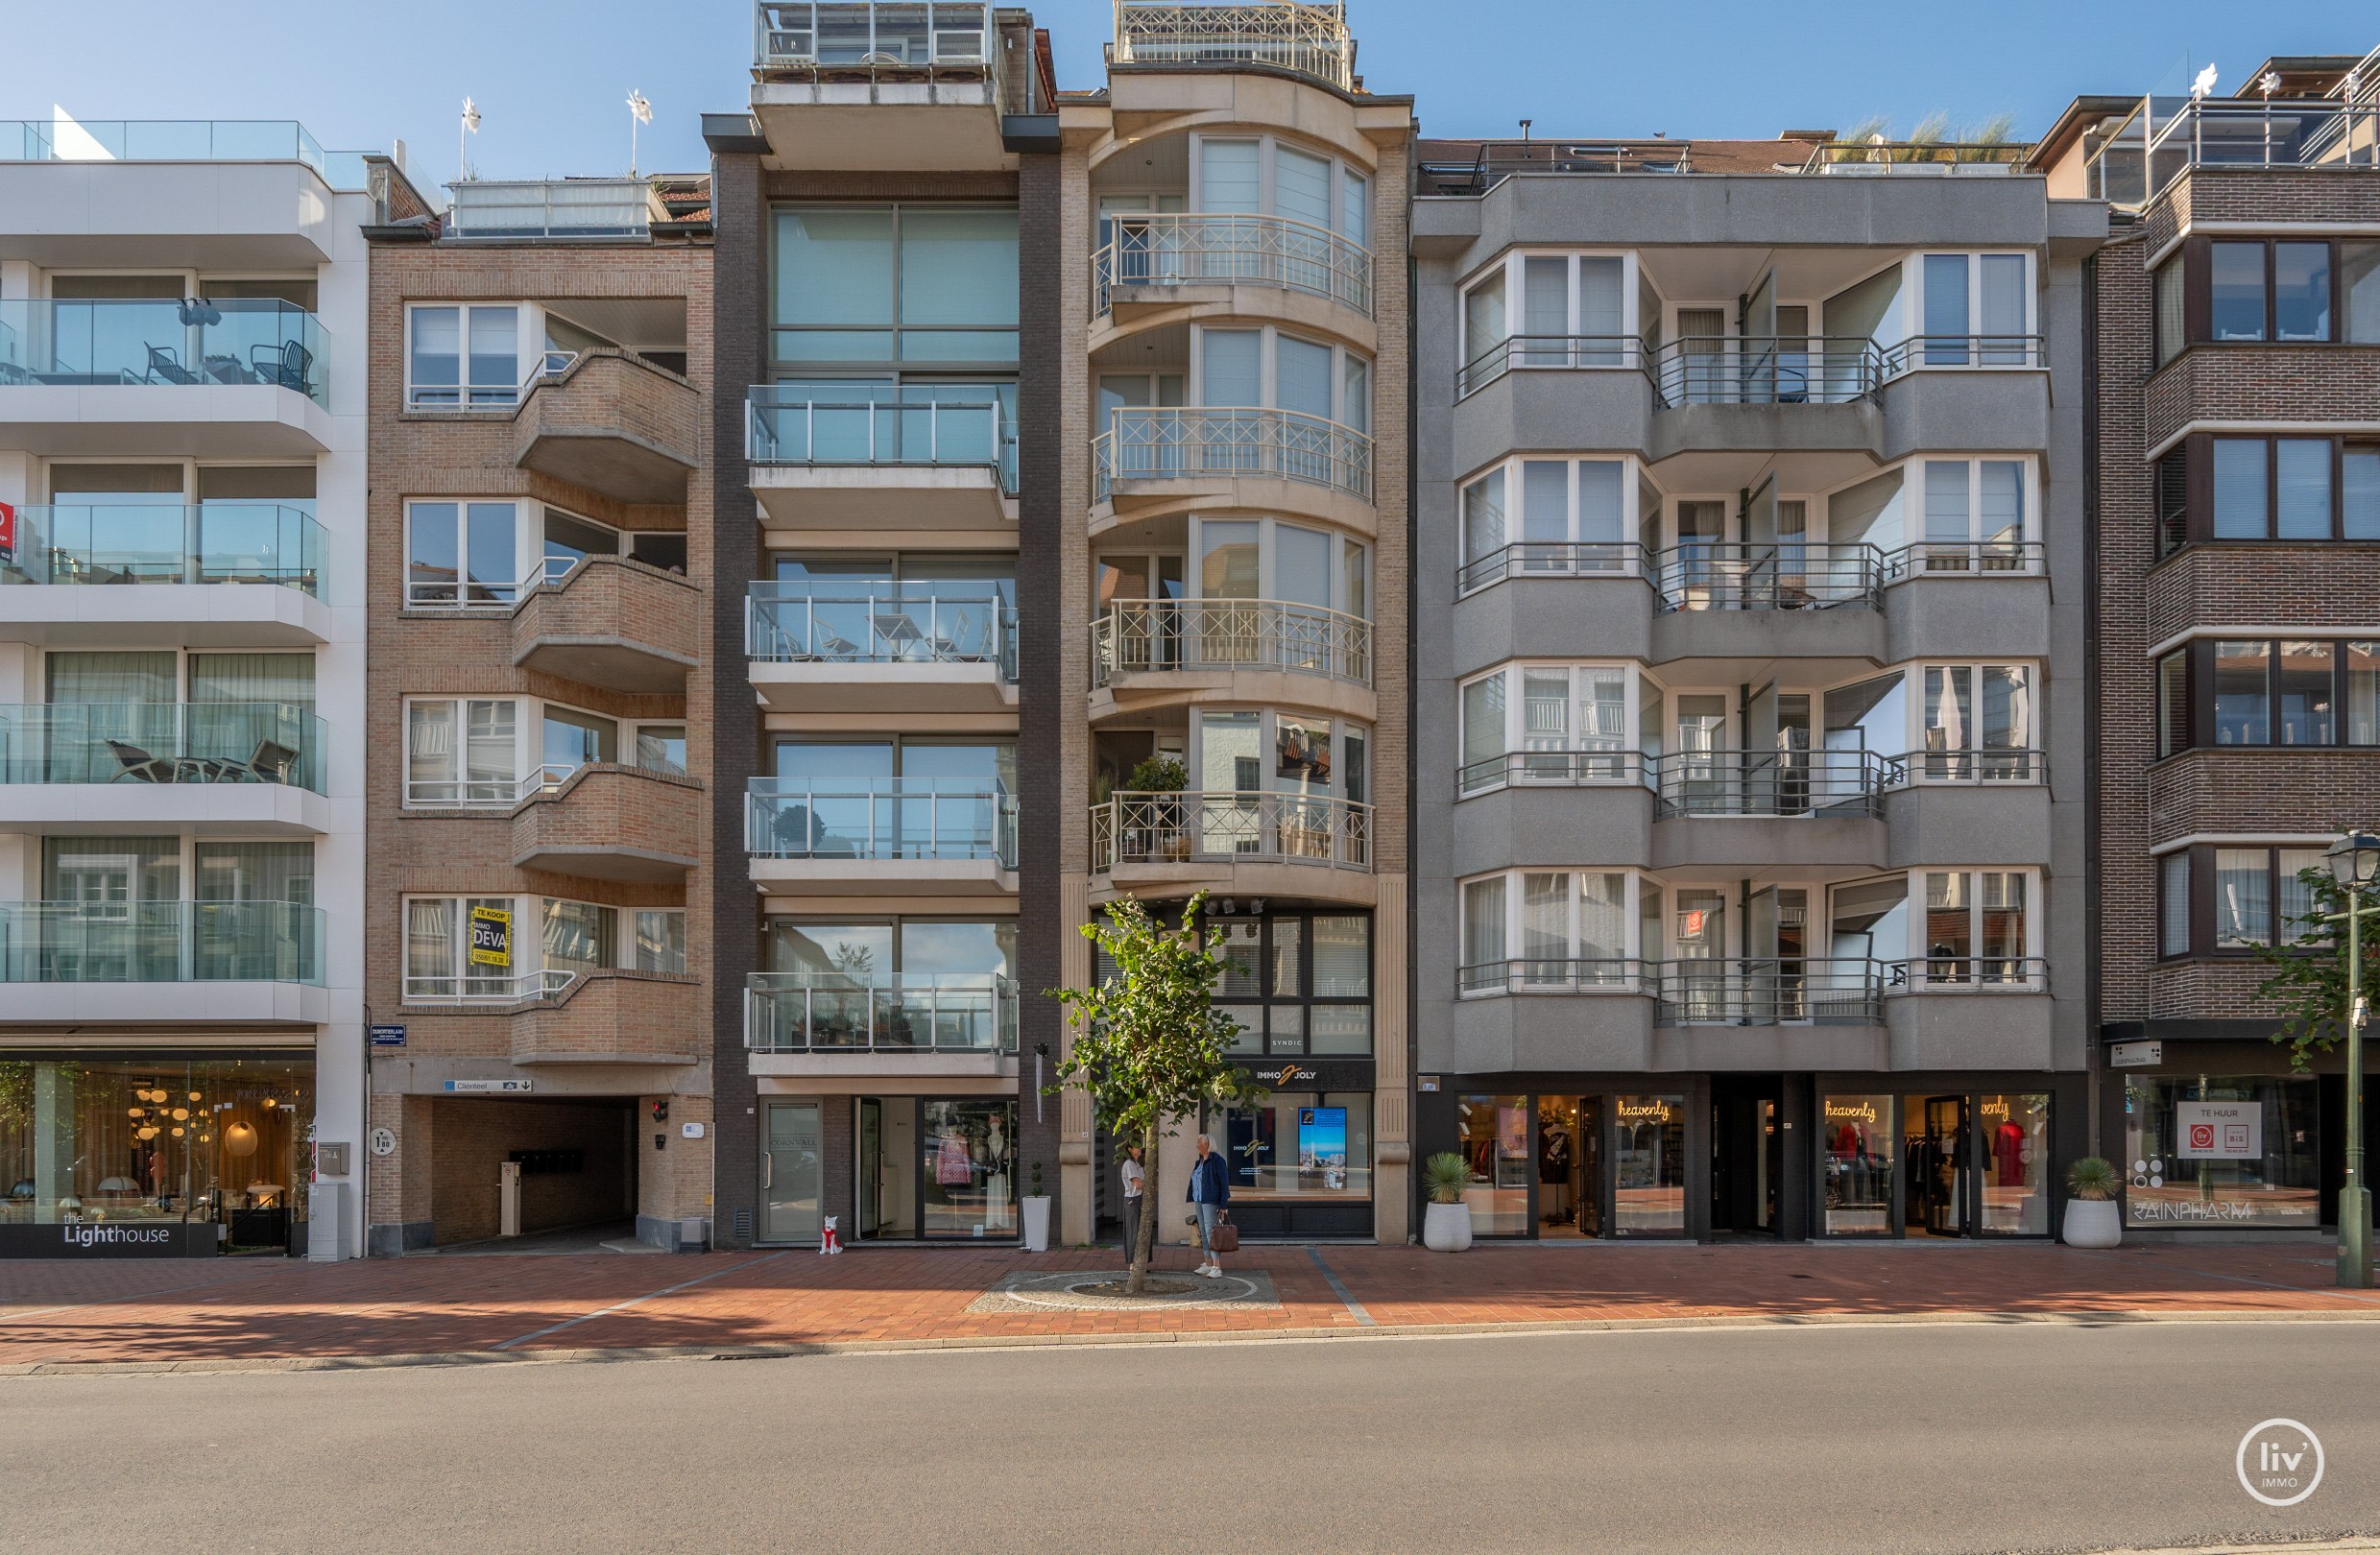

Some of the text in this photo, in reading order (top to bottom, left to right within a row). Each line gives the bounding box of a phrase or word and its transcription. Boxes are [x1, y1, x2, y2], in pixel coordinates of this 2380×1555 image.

[477, 908, 506, 920] TE KOOP
[473, 928, 506, 948] DEVA
[1618, 1100, 1670, 1121] heavenly
[1825, 1100, 1876, 1123] heavenly
[1980, 1094, 2010, 1122] venly
[376, 1136, 380, 1148] 1
[63, 1212, 84, 1224] the
[63, 1225, 170, 1248] Lighthouse
